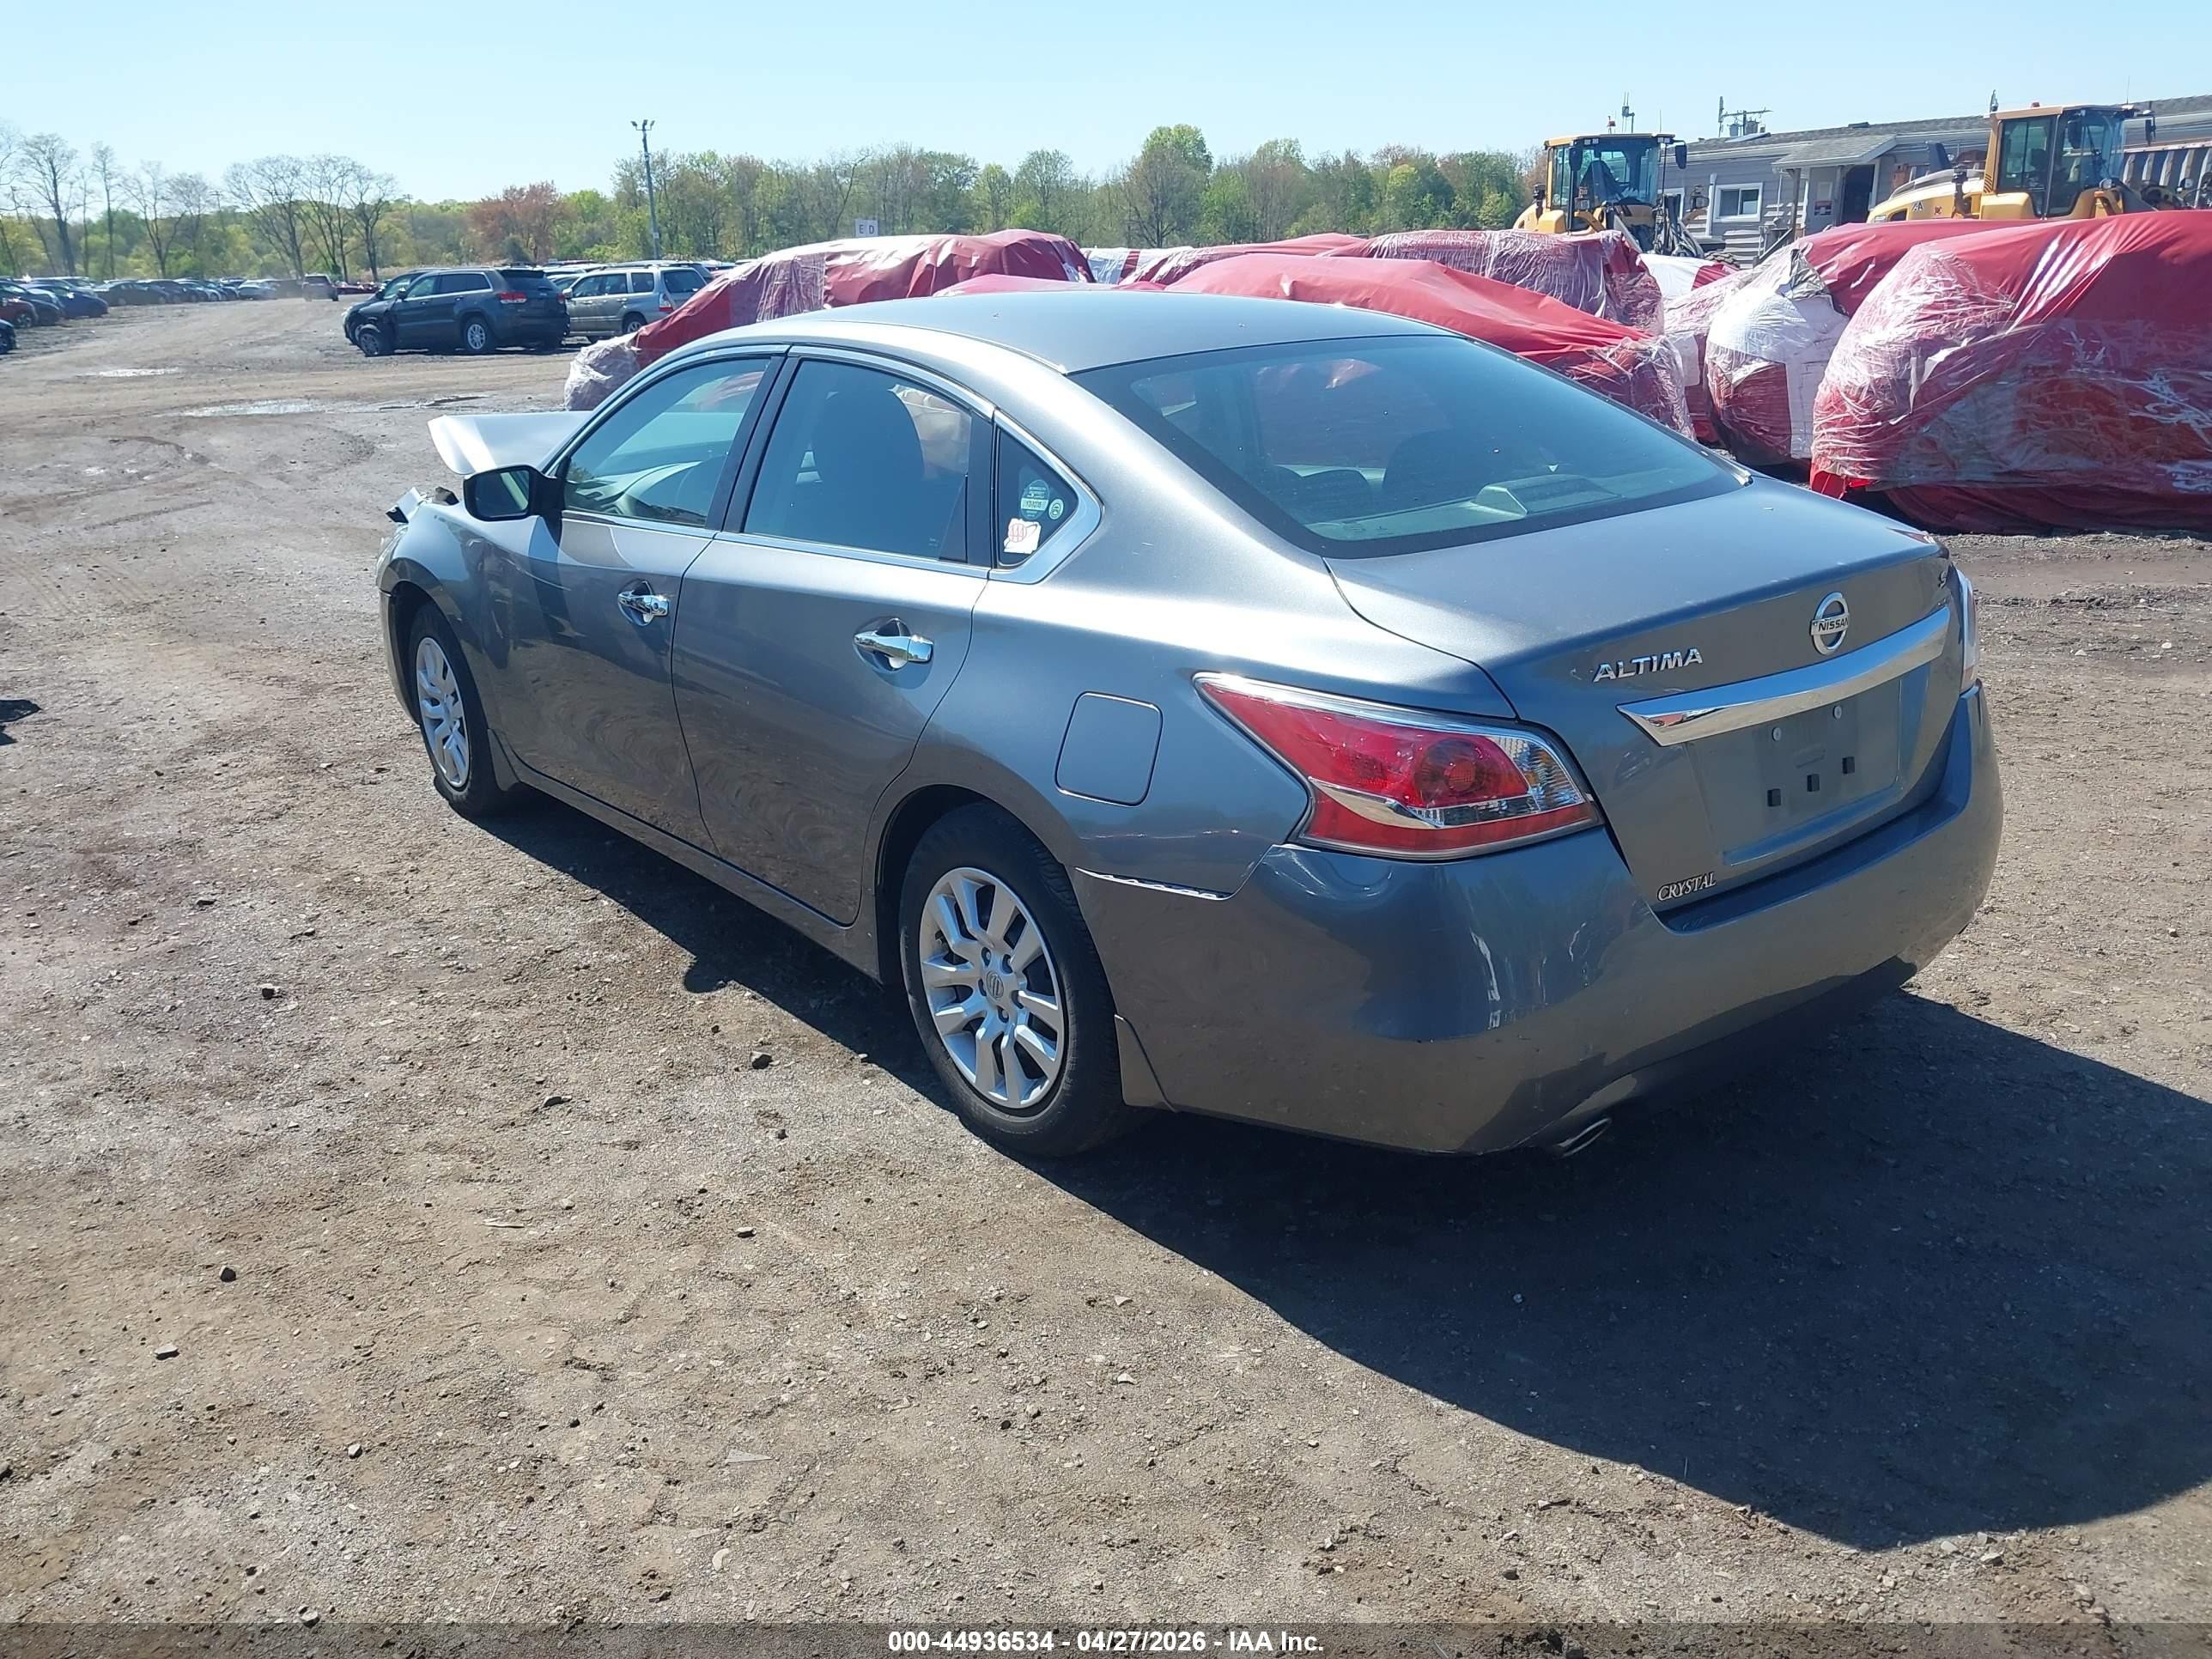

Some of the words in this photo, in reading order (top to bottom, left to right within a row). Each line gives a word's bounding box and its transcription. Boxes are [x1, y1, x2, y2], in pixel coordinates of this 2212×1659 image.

[1818, 618, 1849, 632] NISSAN
[1593, 647, 1704, 683] ALTIMA
[1657, 871, 1717, 902] CRYSTAL
